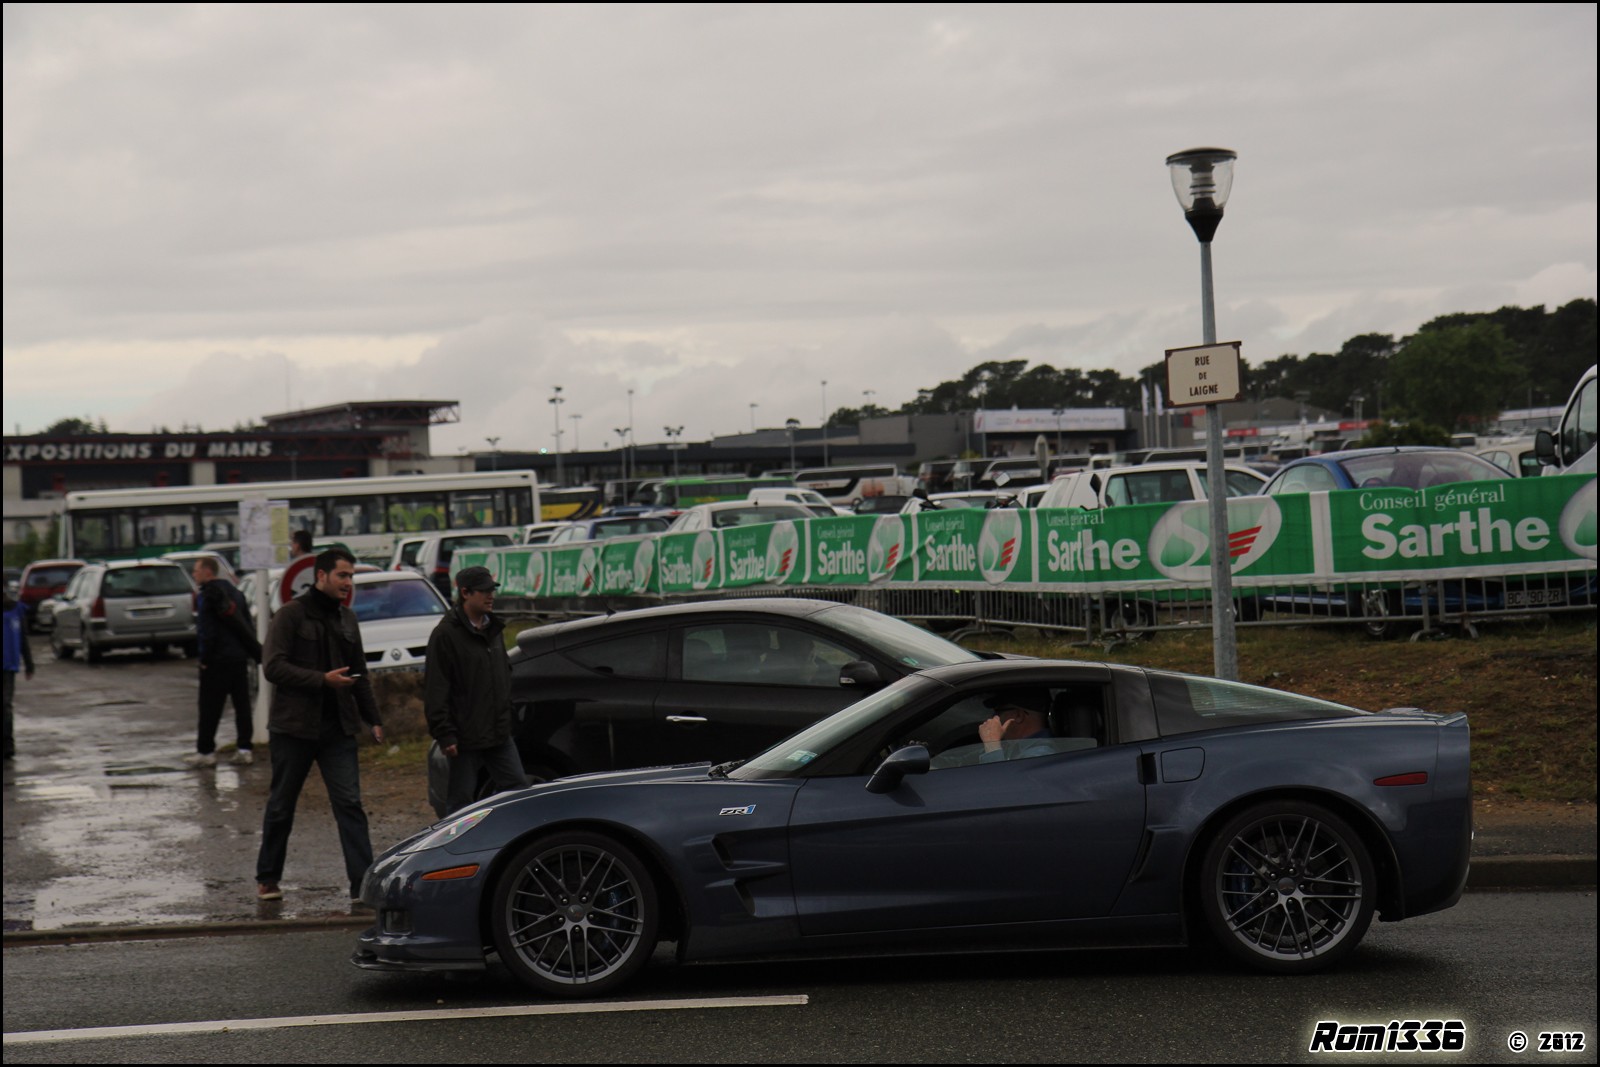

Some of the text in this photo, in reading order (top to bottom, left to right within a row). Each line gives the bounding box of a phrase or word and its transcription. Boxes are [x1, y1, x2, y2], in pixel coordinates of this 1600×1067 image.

[1195, 355, 1210, 366] RUE
[1198, 371, 1207, 380] DE
[1189, 384, 1219, 397] LAIGNE
[4, 441, 272, 461] XPOSITIONS DU MANS
[1359, 483, 1506, 511] Conseil général
[1361, 507, 1550, 560] Sarthe
[729, 548, 765, 581] Sarthe
[818, 540, 865, 576] Sarthe
[925, 533, 976, 572] Sarthe
[1047, 529, 1142, 572] Sarthe
[719, 804, 757, 816] ZR1
